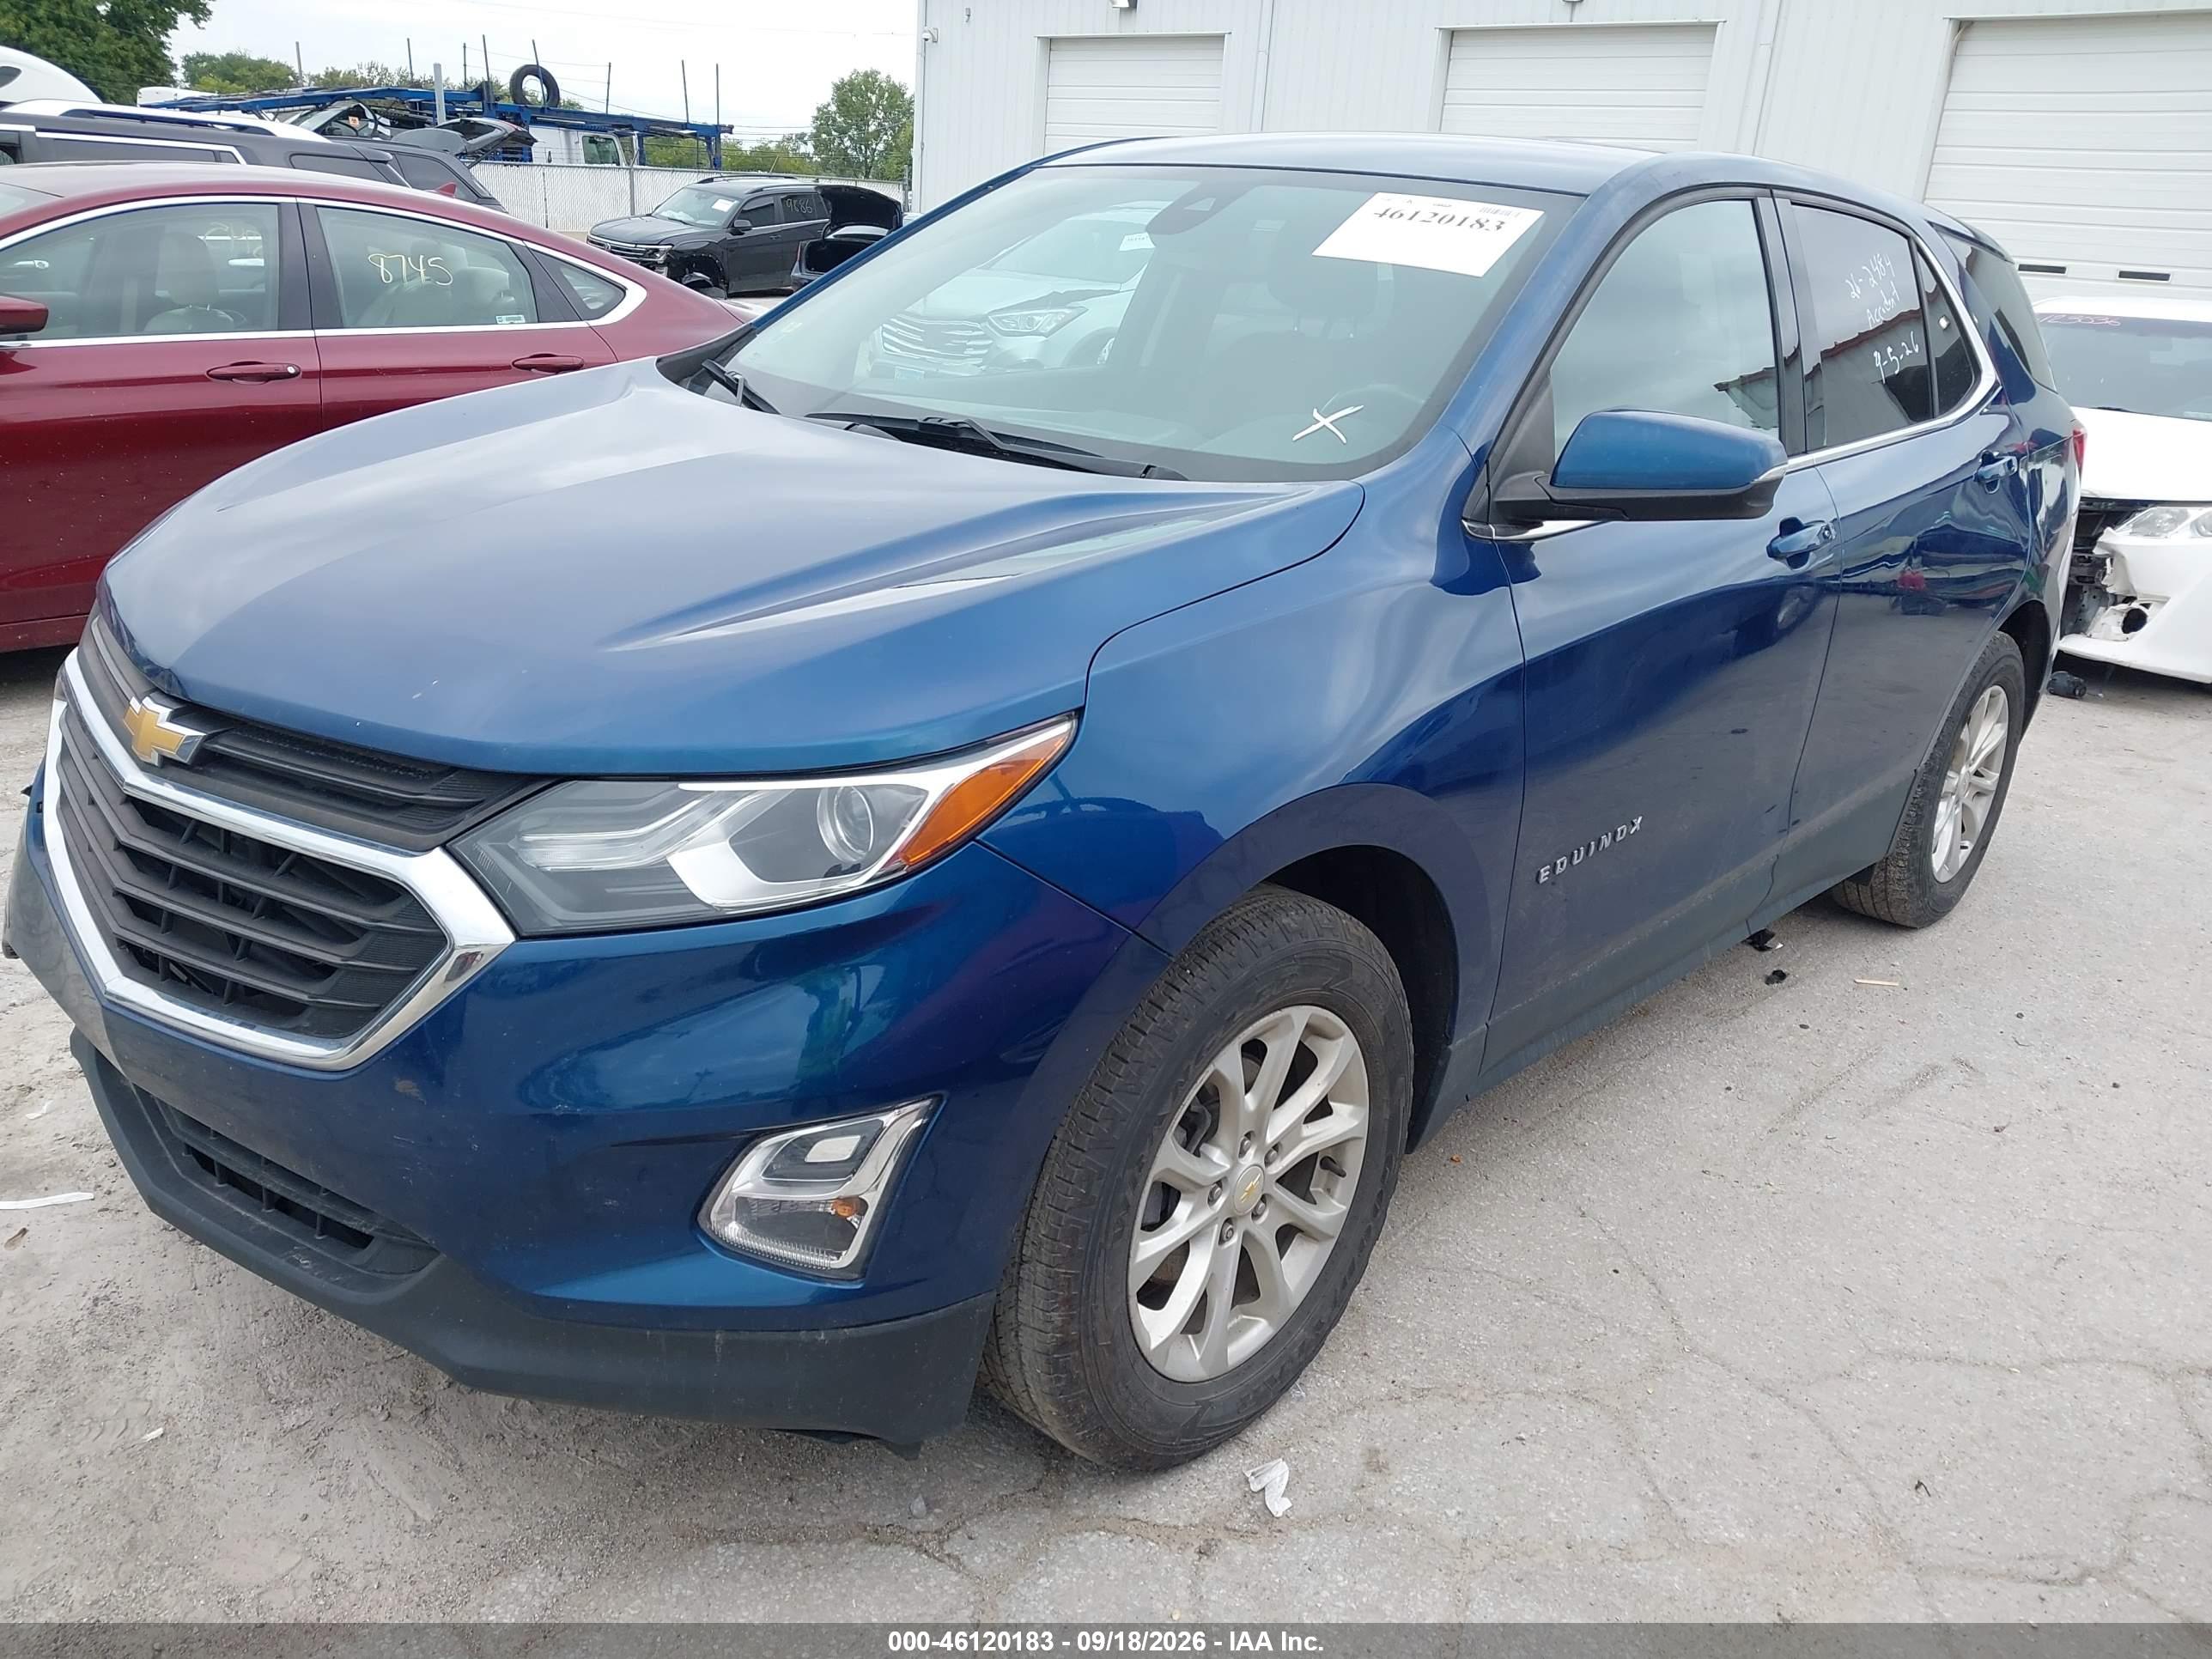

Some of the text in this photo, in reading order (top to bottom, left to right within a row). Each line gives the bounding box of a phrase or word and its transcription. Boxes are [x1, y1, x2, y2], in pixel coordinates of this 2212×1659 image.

[1373, 207, 1505, 232] 46120183
[368, 253, 453, 287] 8745
[1536, 815, 1643, 884] EQUINOX
